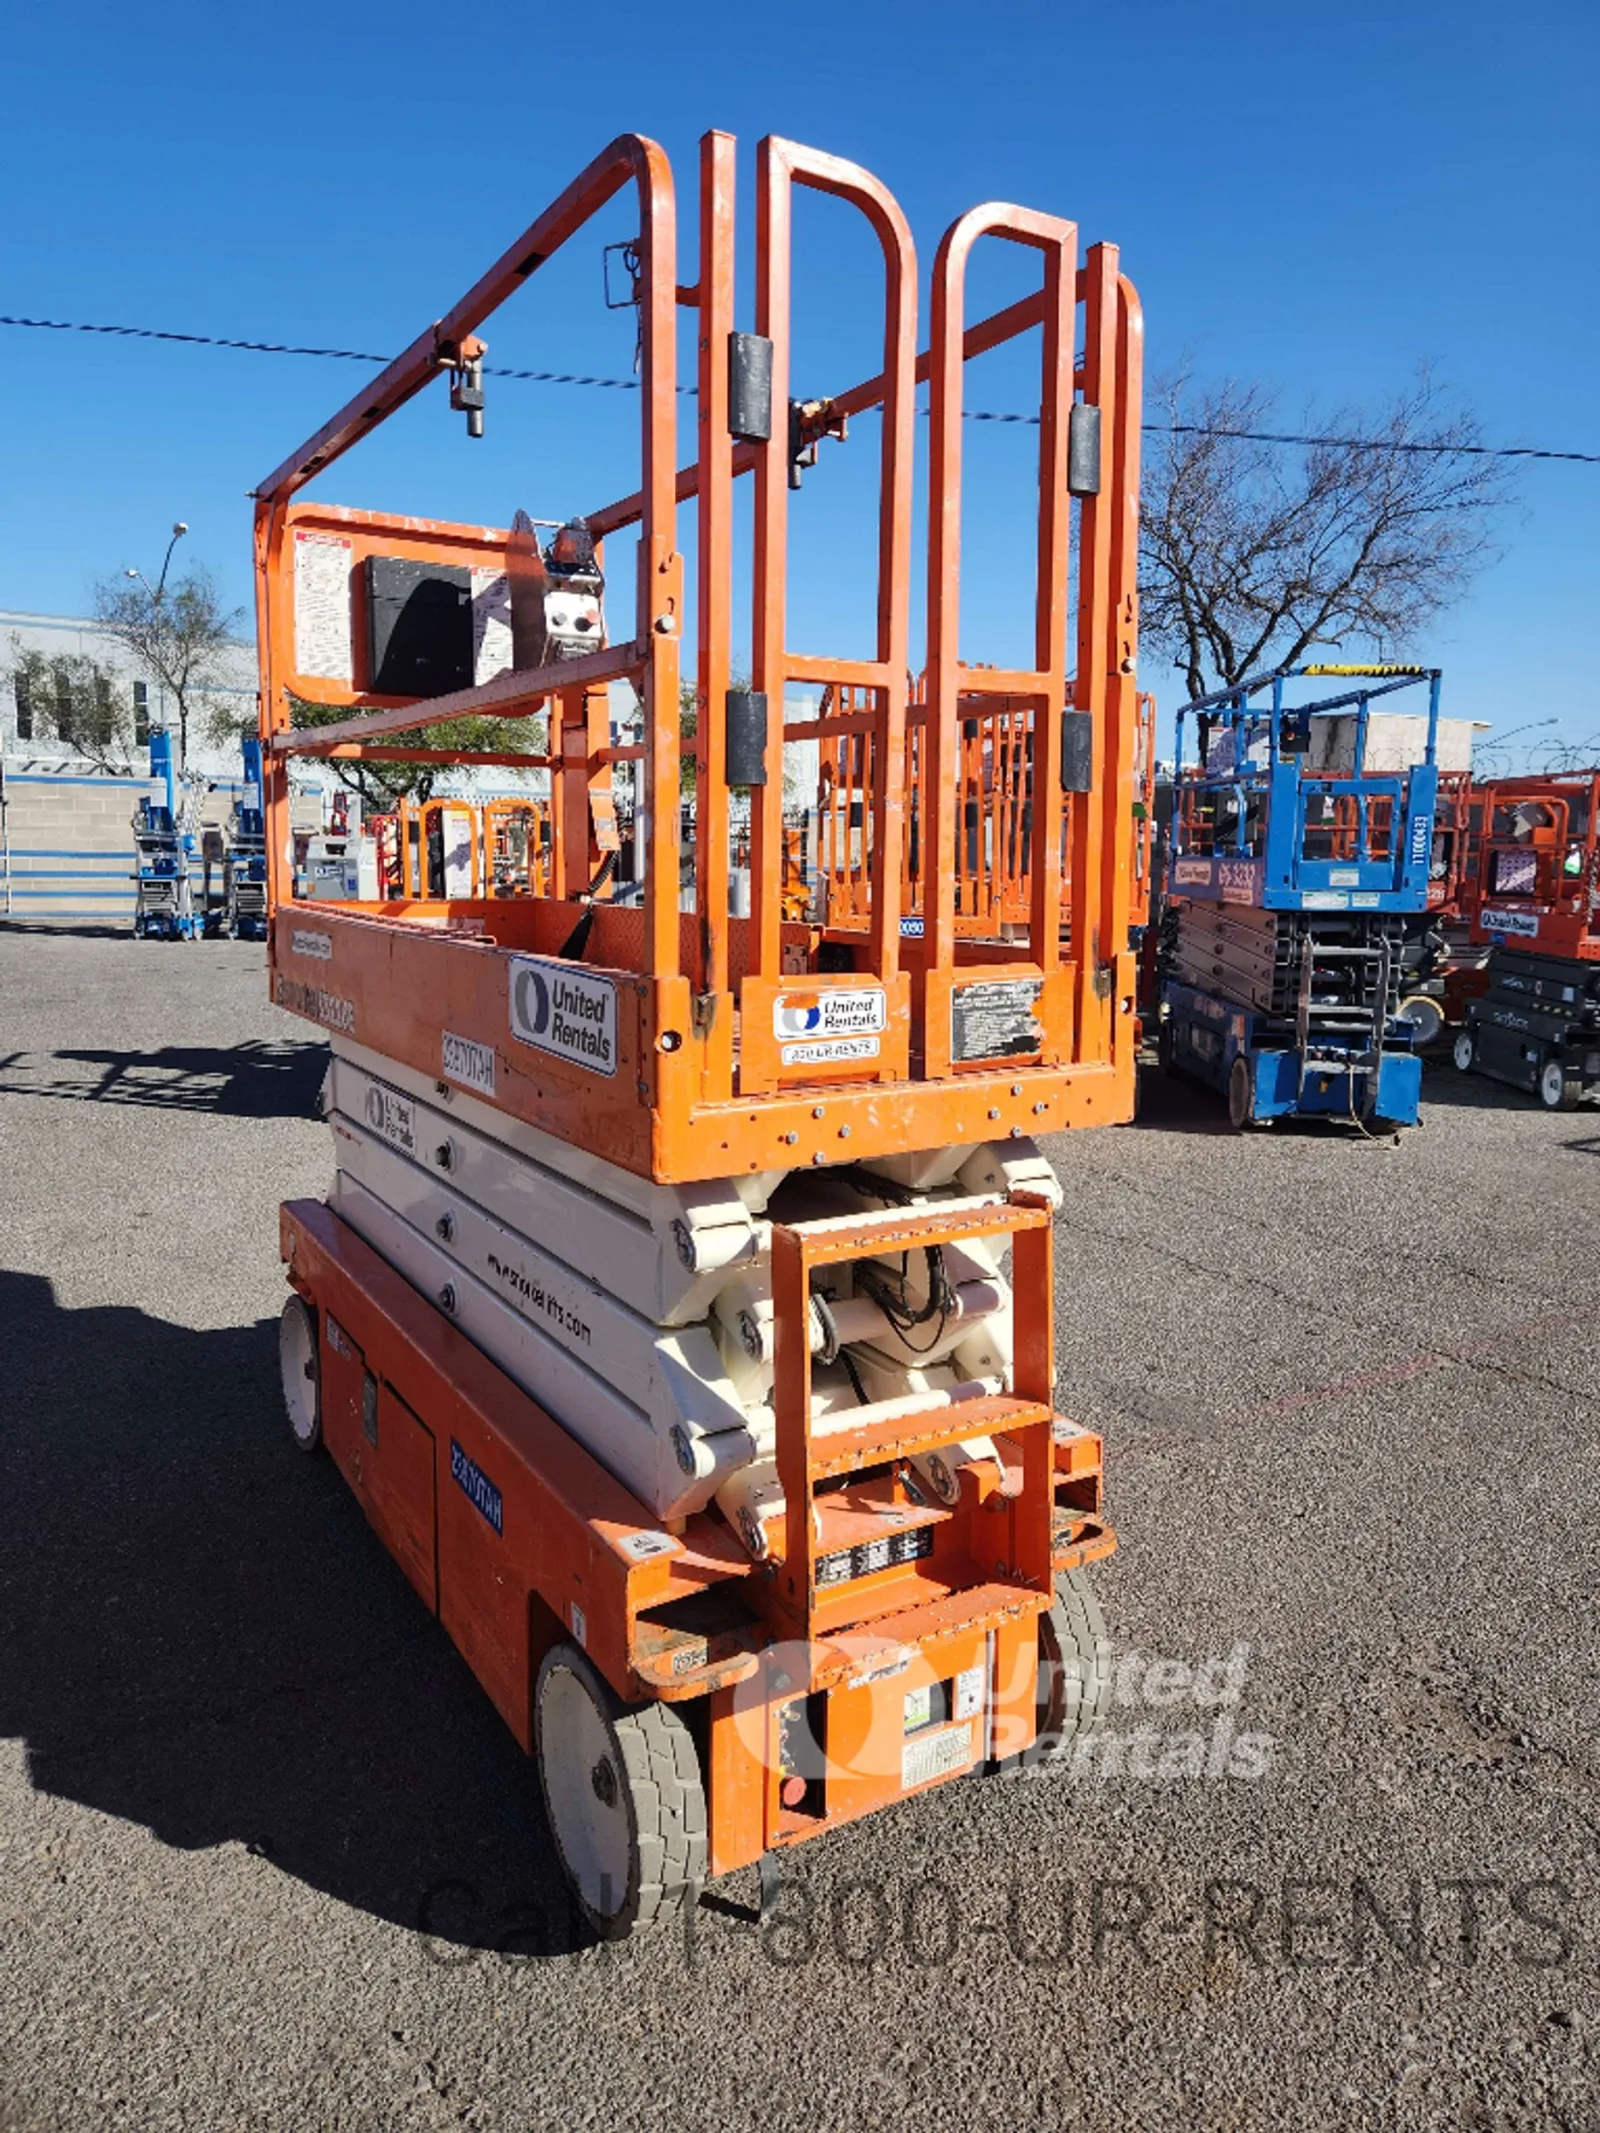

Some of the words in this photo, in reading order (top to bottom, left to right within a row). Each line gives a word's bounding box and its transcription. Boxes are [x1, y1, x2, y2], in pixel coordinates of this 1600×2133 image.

[552, 979, 607, 1024] United
[825, 998, 875, 1014] United
[825, 1013, 877, 1028] Rentals
[552, 1012, 611, 1062] Rentals
